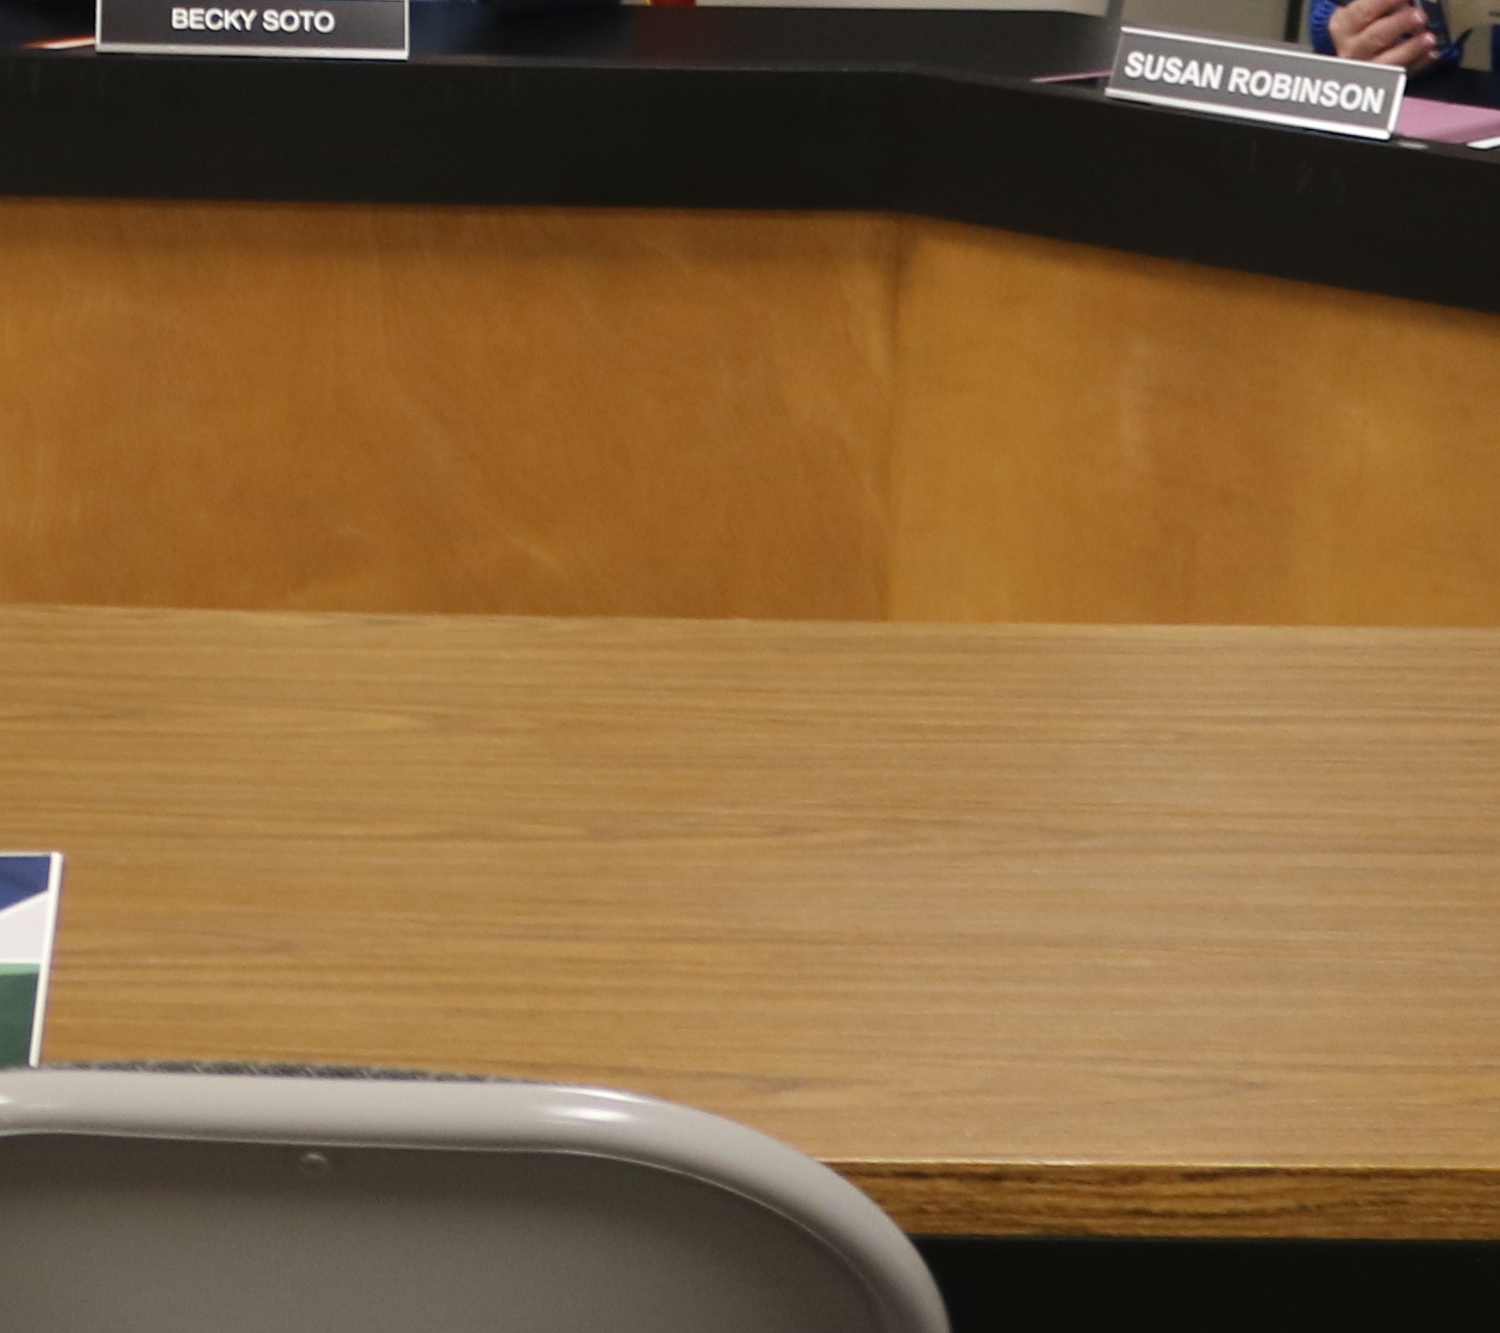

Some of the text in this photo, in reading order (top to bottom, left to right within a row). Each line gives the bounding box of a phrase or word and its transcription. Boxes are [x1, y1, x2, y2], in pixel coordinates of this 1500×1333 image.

[170, 7, 336, 33] BECKY SOTO
[1123, 51, 1386, 115] SUSAN ROBINSON
